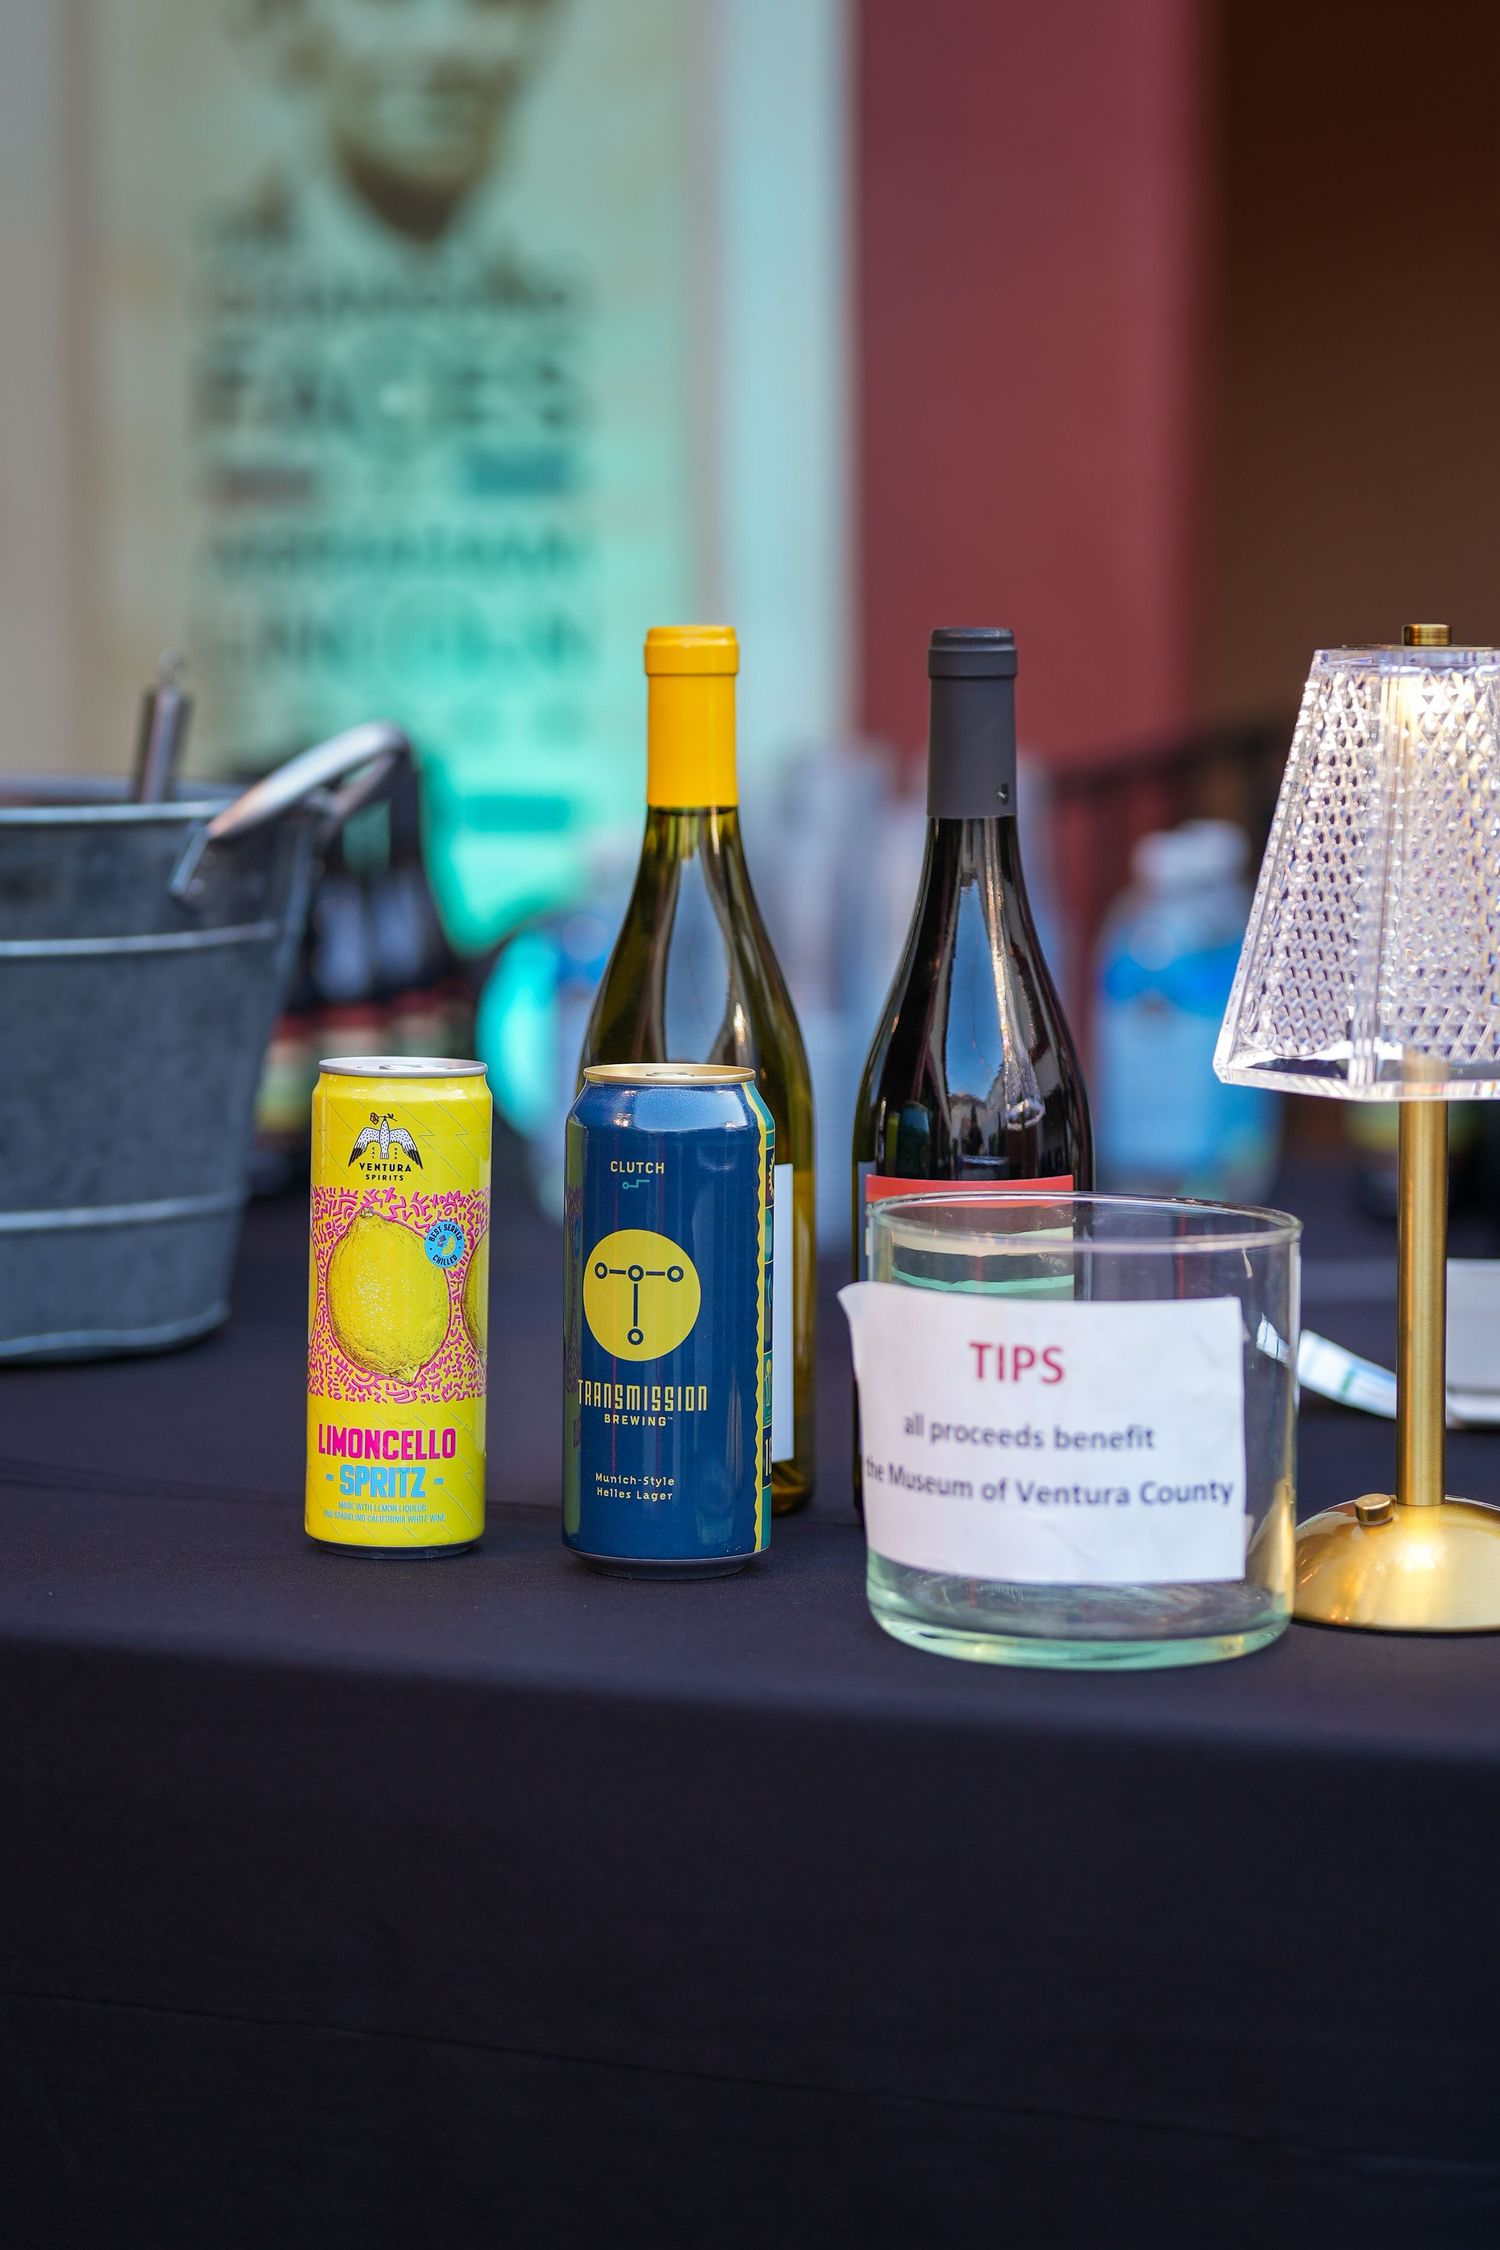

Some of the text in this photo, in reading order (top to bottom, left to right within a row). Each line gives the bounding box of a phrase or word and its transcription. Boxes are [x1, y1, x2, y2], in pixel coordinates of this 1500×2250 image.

[359, 1162, 412, 1172] VENTURA
[610, 1160, 665, 1174] CLUTCH
[428, 1223, 463, 1243] BEST SERVED
[432, 1254, 458, 1266] CHILLED
[969, 1341, 1065, 1384] TIPS
[577, 1379, 708, 1412] TRANSMISSION
[318, 1423, 456, 1461] LIMONCELLO
[904, 1413, 1155, 1449] all proceeds benefit
[339, 1464, 426, 1498] SPRITZ
[595, 1472, 675, 1487] Munich-Style
[865, 1456, 1234, 1507] the Museum of Ventura County
[596, 1486, 673, 1502] Helles Lager
